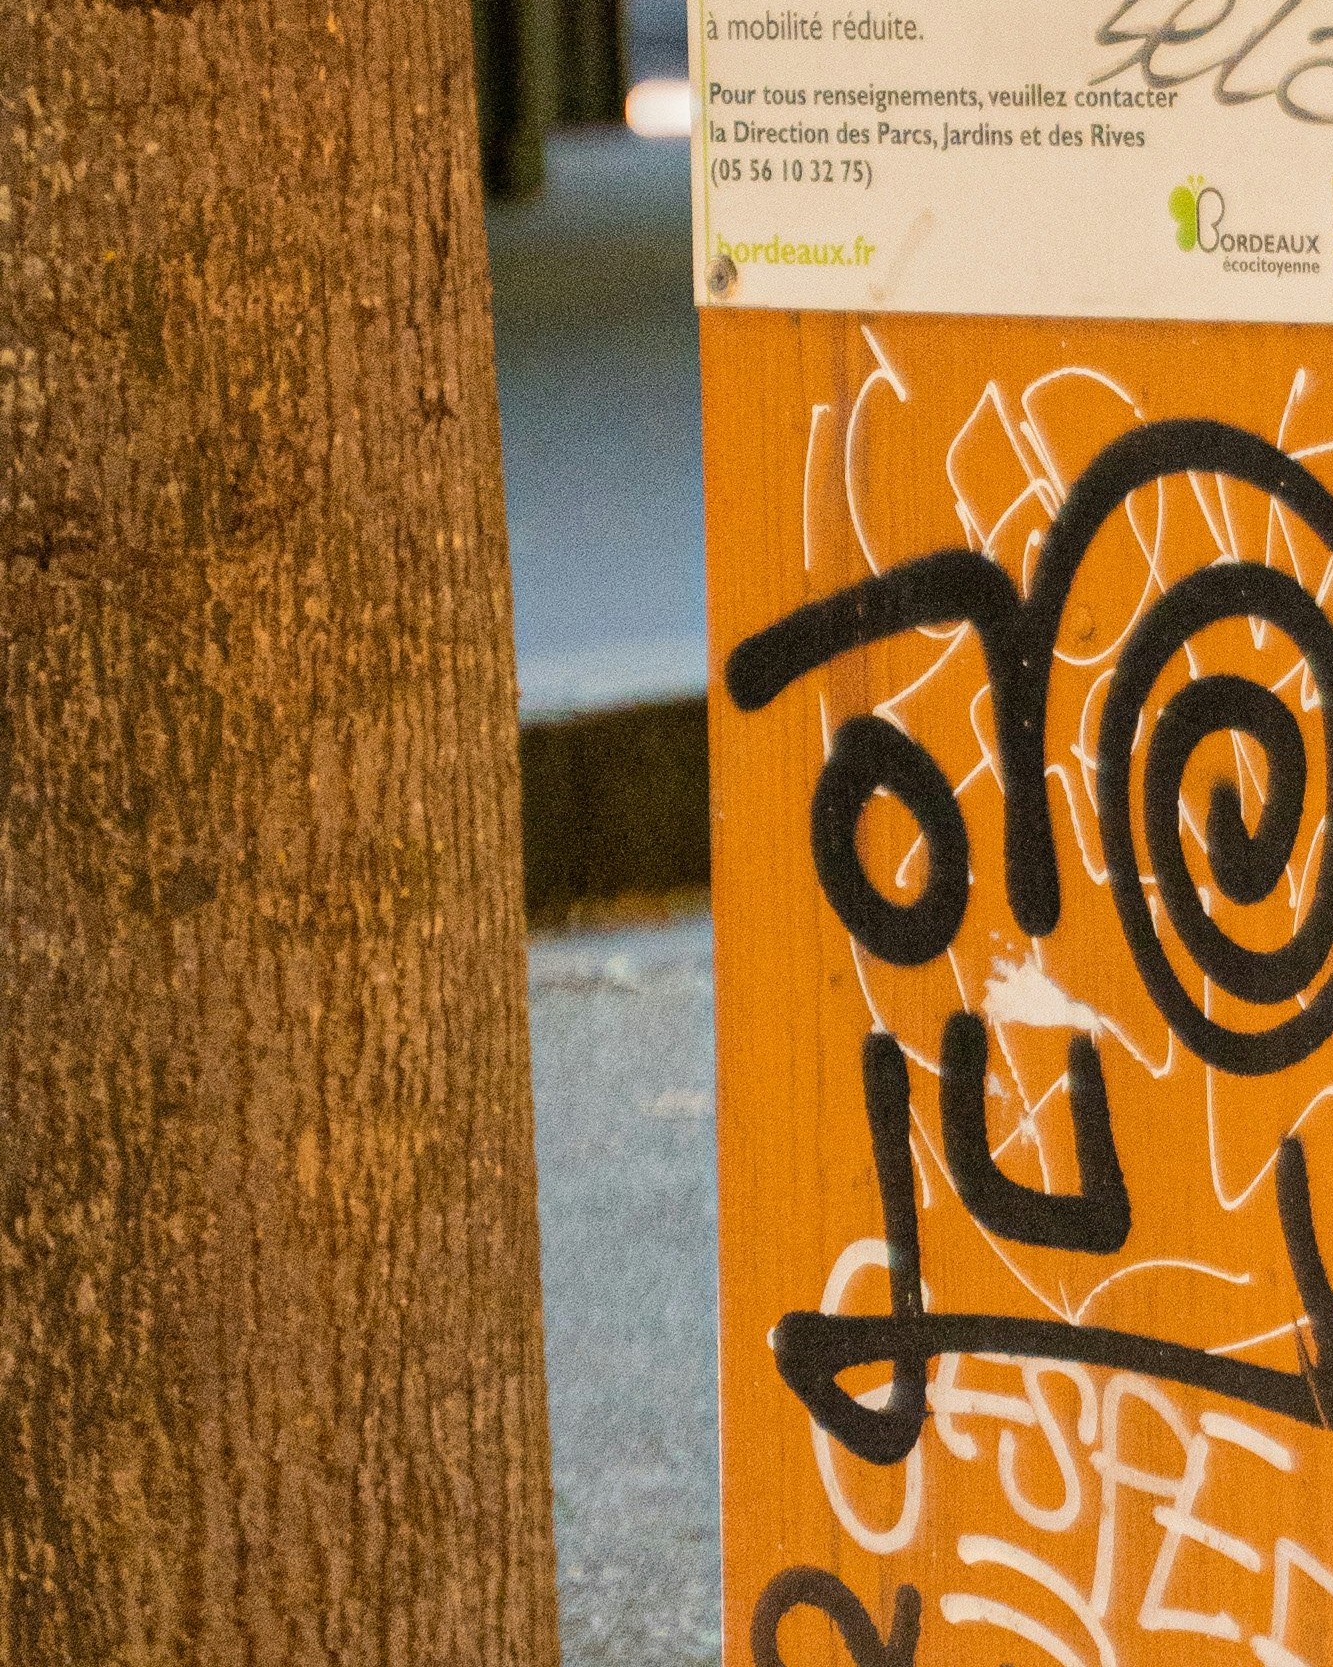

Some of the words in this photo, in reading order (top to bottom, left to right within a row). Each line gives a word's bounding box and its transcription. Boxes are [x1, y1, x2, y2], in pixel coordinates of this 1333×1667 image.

[706, 11, 720, 42] à
[727, 9, 824, 41] mobilité
[832, 9, 926, 42] réduite.
[709, 81, 757, 107] Pour
[763, 84, 807, 107] tous
[813, 84, 984, 114] renseignements,
[988, 83, 1068, 108] veuillez
[1073, 86, 1179, 109] contacter
[709, 120, 728, 144] la
[733, 120, 830, 145] Direction
[836, 120, 870, 146] des
[877, 120, 938, 149] Parcs,
[941, 120, 1014, 152] Jardins
[1020, 125, 1042, 147] et
[1049, 122, 1084, 148] des
[1090, 122, 1146, 148] Rives
[710, 157, 742, 188] (05
[750, 157, 773, 182] 56
[781, 158, 804, 183] 10
[810, 158, 834, 183] 32
[840, 158, 873, 191] 75)
[717, 231, 877, 266] bordeaux.fr
[1223, 256, 1321, 278] écocitoyenne
